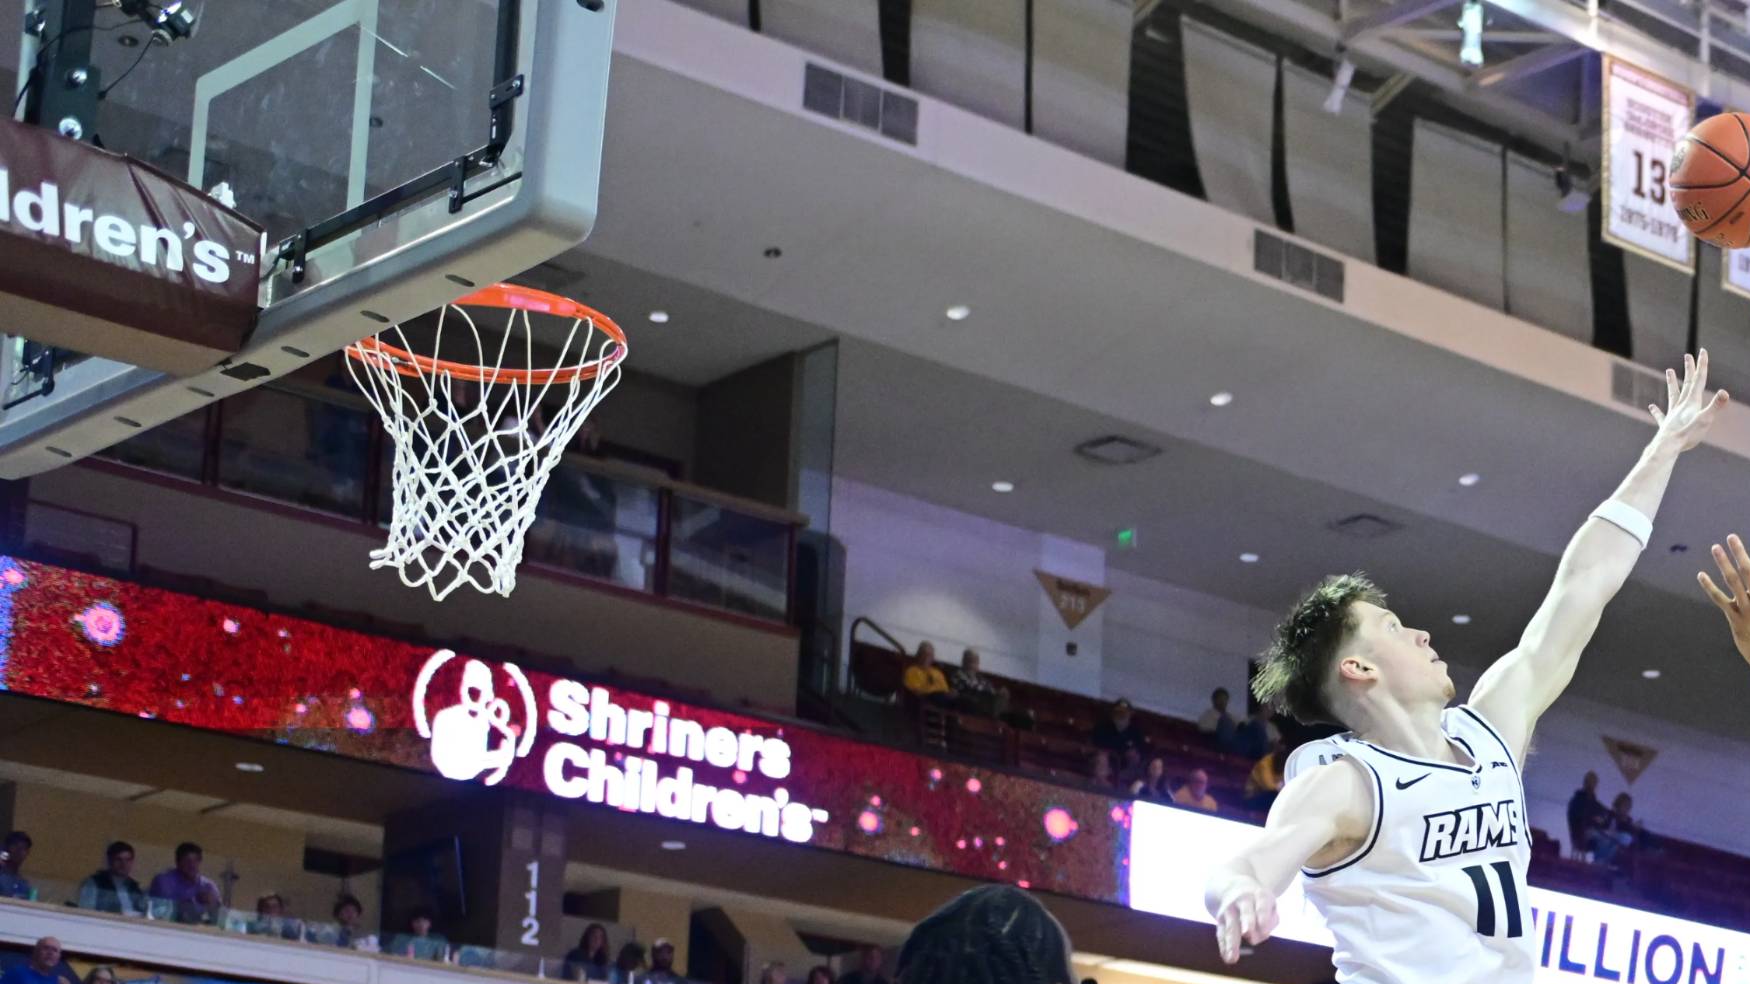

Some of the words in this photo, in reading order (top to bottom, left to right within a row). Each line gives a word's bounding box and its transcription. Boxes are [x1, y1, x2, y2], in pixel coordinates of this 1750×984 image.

[1633, 150, 1666, 206] 13
[548, 679, 792, 779] Shriners
[543, 741, 815, 843] Children's
[1461, 861, 1523, 938] 11
